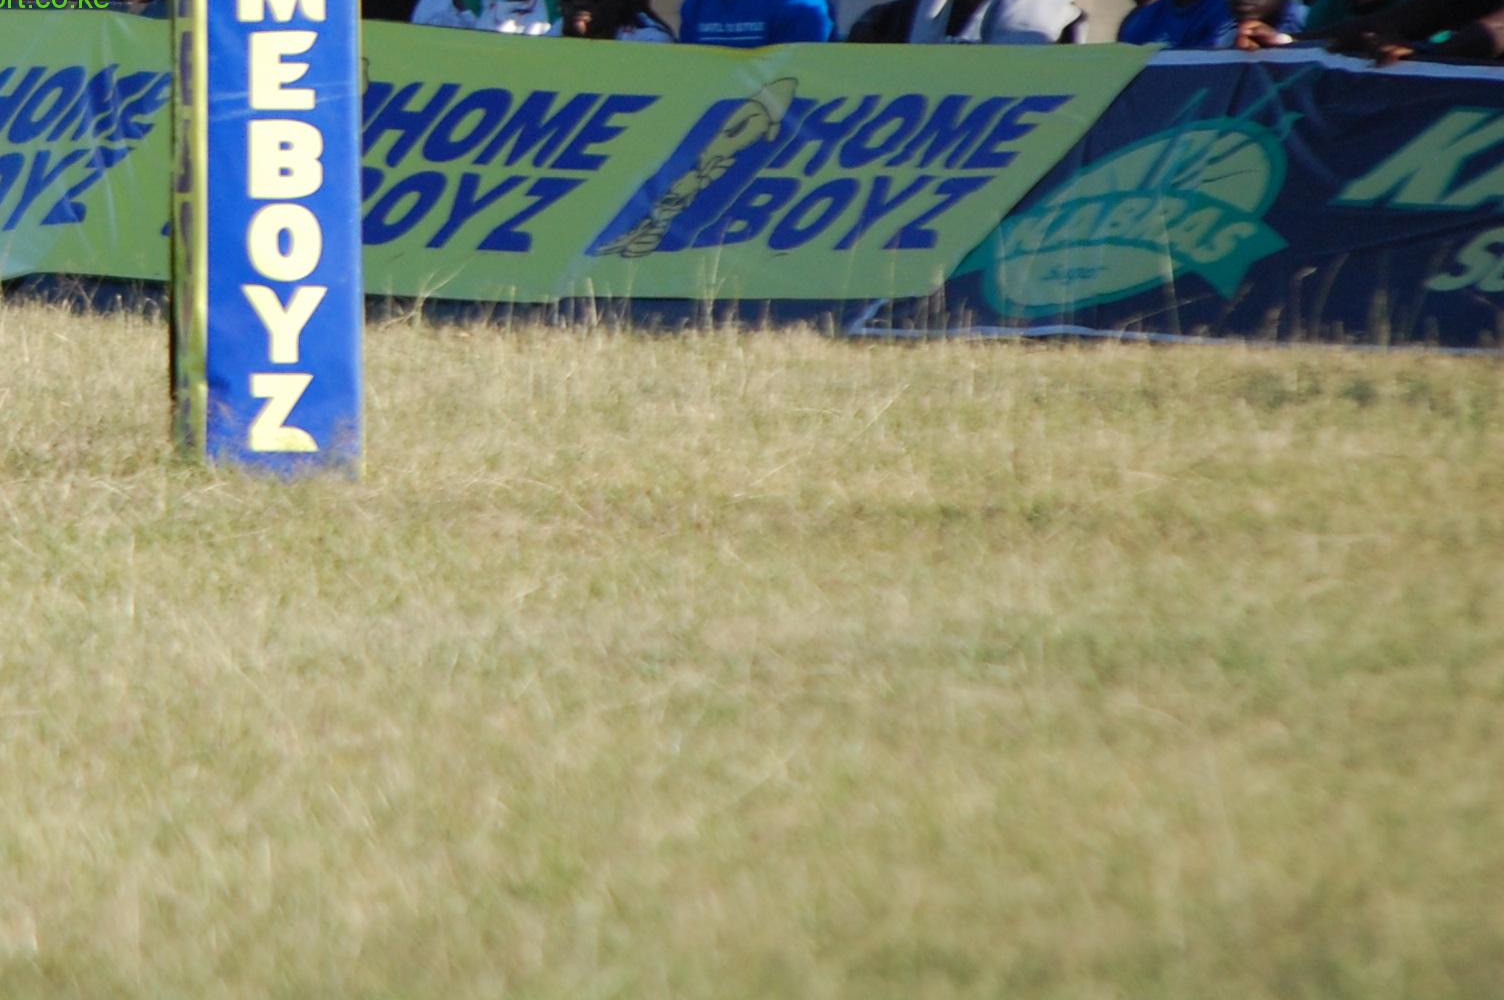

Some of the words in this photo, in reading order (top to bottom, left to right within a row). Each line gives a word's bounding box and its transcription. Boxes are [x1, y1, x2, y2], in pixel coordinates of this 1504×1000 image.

[363, 81, 662, 171] HOME
[767, 93, 1076, 177] HOME
[691, 174, 998, 251] BOYZ
[999, 196, 1258, 264] KABRAS
